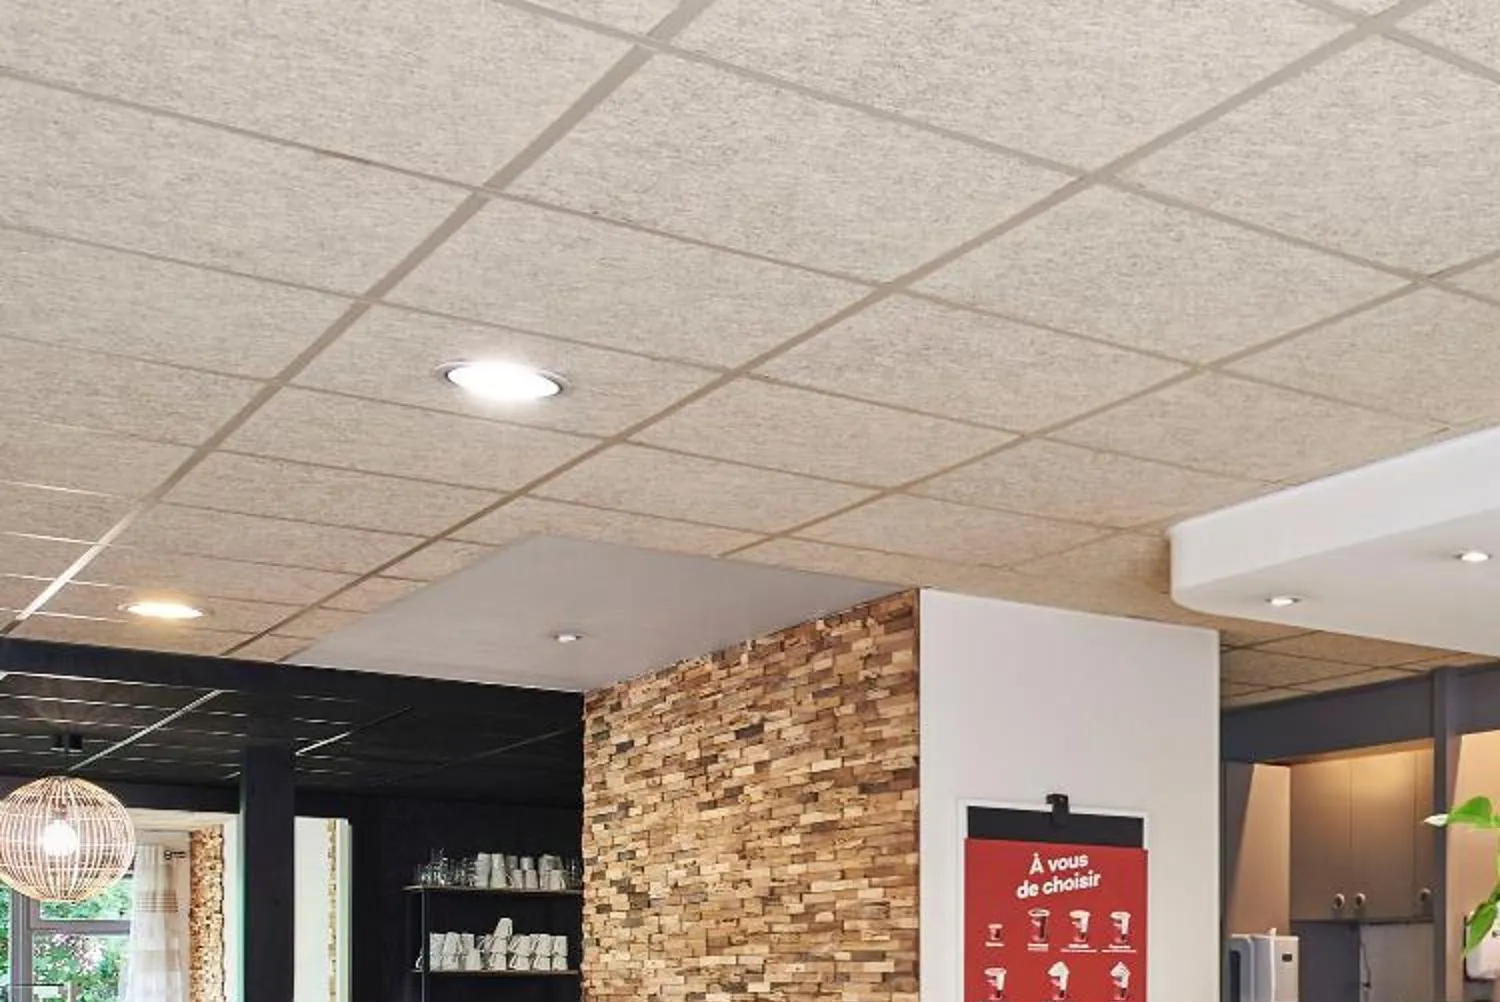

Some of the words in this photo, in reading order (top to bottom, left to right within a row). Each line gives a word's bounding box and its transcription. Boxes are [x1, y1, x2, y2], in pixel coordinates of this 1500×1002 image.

[1047, 854, 1089, 872] vous
[1016, 880, 1040, 899] de
[1042, 870, 1101, 895] choisir
